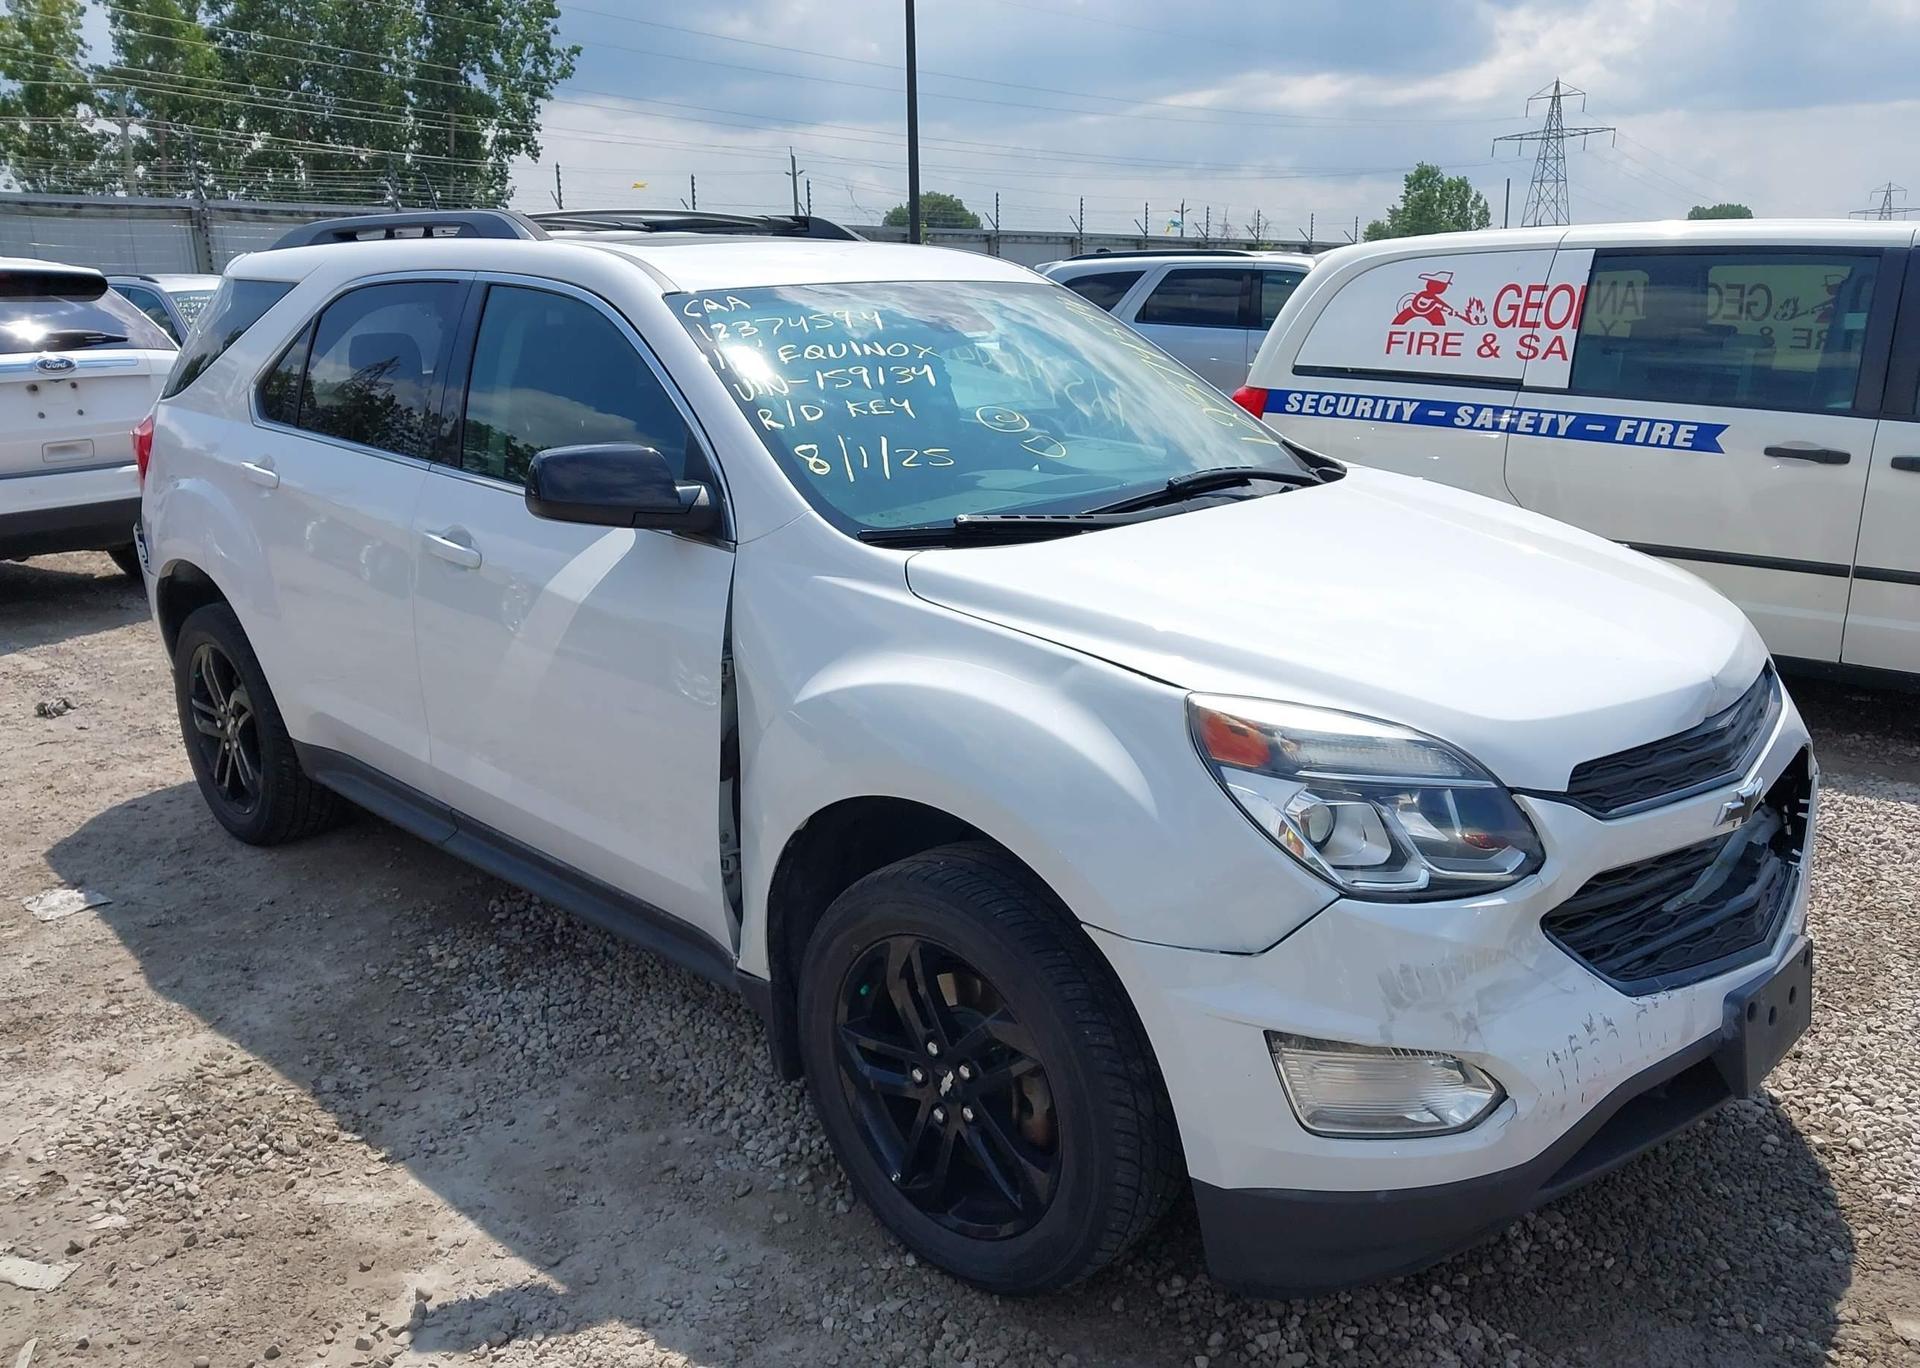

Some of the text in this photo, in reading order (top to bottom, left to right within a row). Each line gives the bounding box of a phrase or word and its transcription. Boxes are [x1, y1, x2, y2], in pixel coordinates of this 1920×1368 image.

[684, 296, 751, 317] CAA
[696, 310, 883, 342] 12374594
[778, 340, 945, 365] EQUINOX
[1385, 331, 1569, 362] FIRE & SA
[756, 397, 917, 431] R/D KEY
[1285, 393, 1421, 422] SECURITY
[1453, 405, 1577, 437] SAFETY
[1614, 419, 1699, 449] FIRE
[794, 434, 955, 483] 8/1/25
